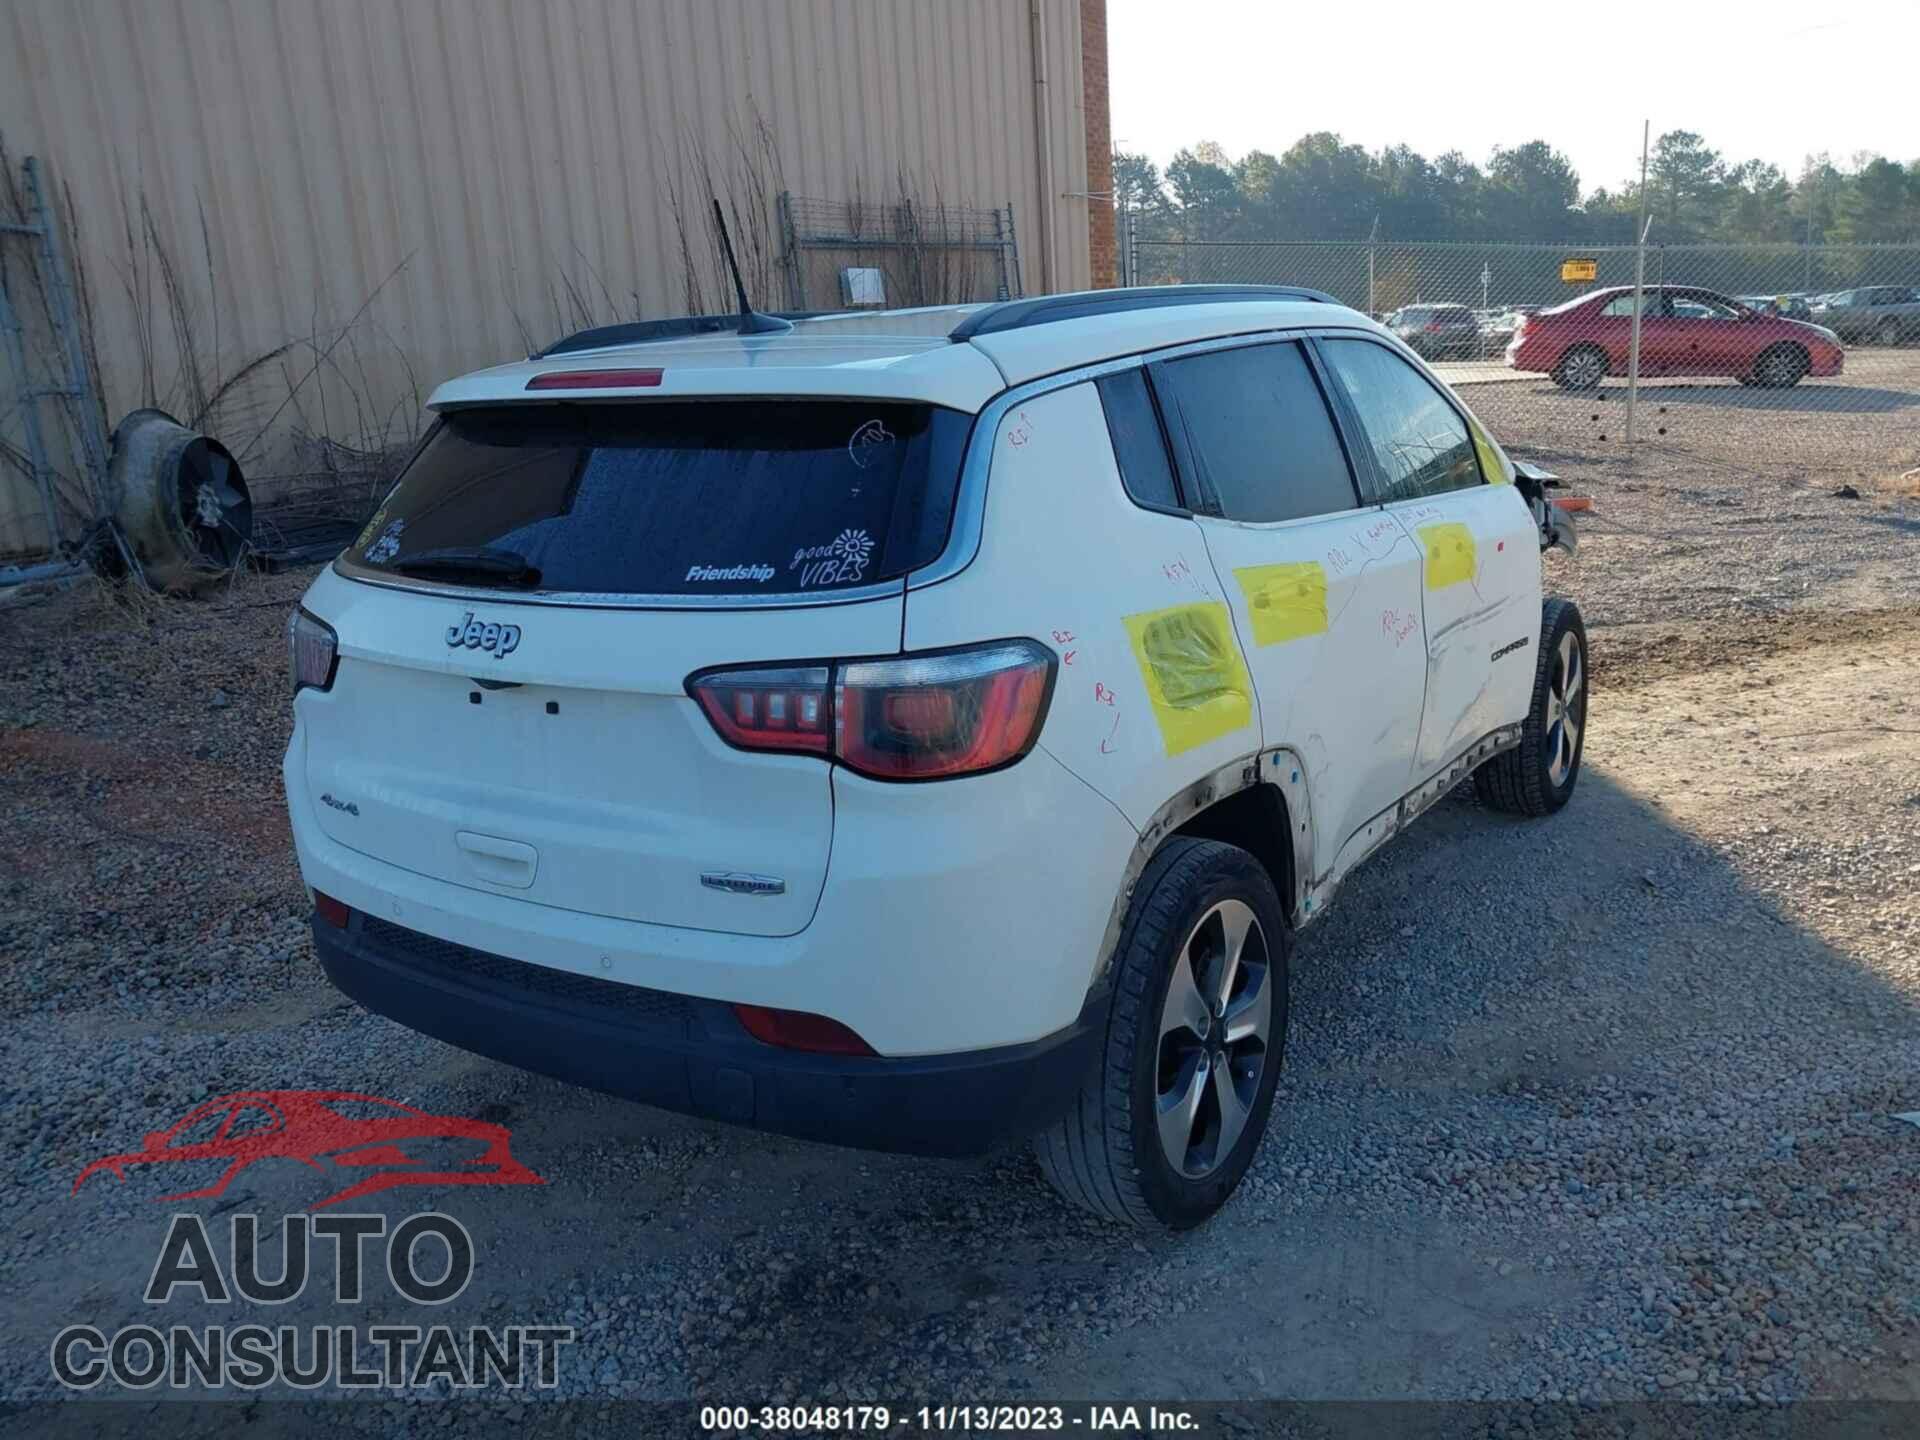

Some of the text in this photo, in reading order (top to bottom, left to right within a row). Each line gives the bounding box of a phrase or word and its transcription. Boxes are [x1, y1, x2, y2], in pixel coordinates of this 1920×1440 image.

[789, 536, 842, 570] good
[685, 564, 775, 583] Friendship
[800, 557, 870, 587] VIBES
[446, 612, 521, 660] Jeep
